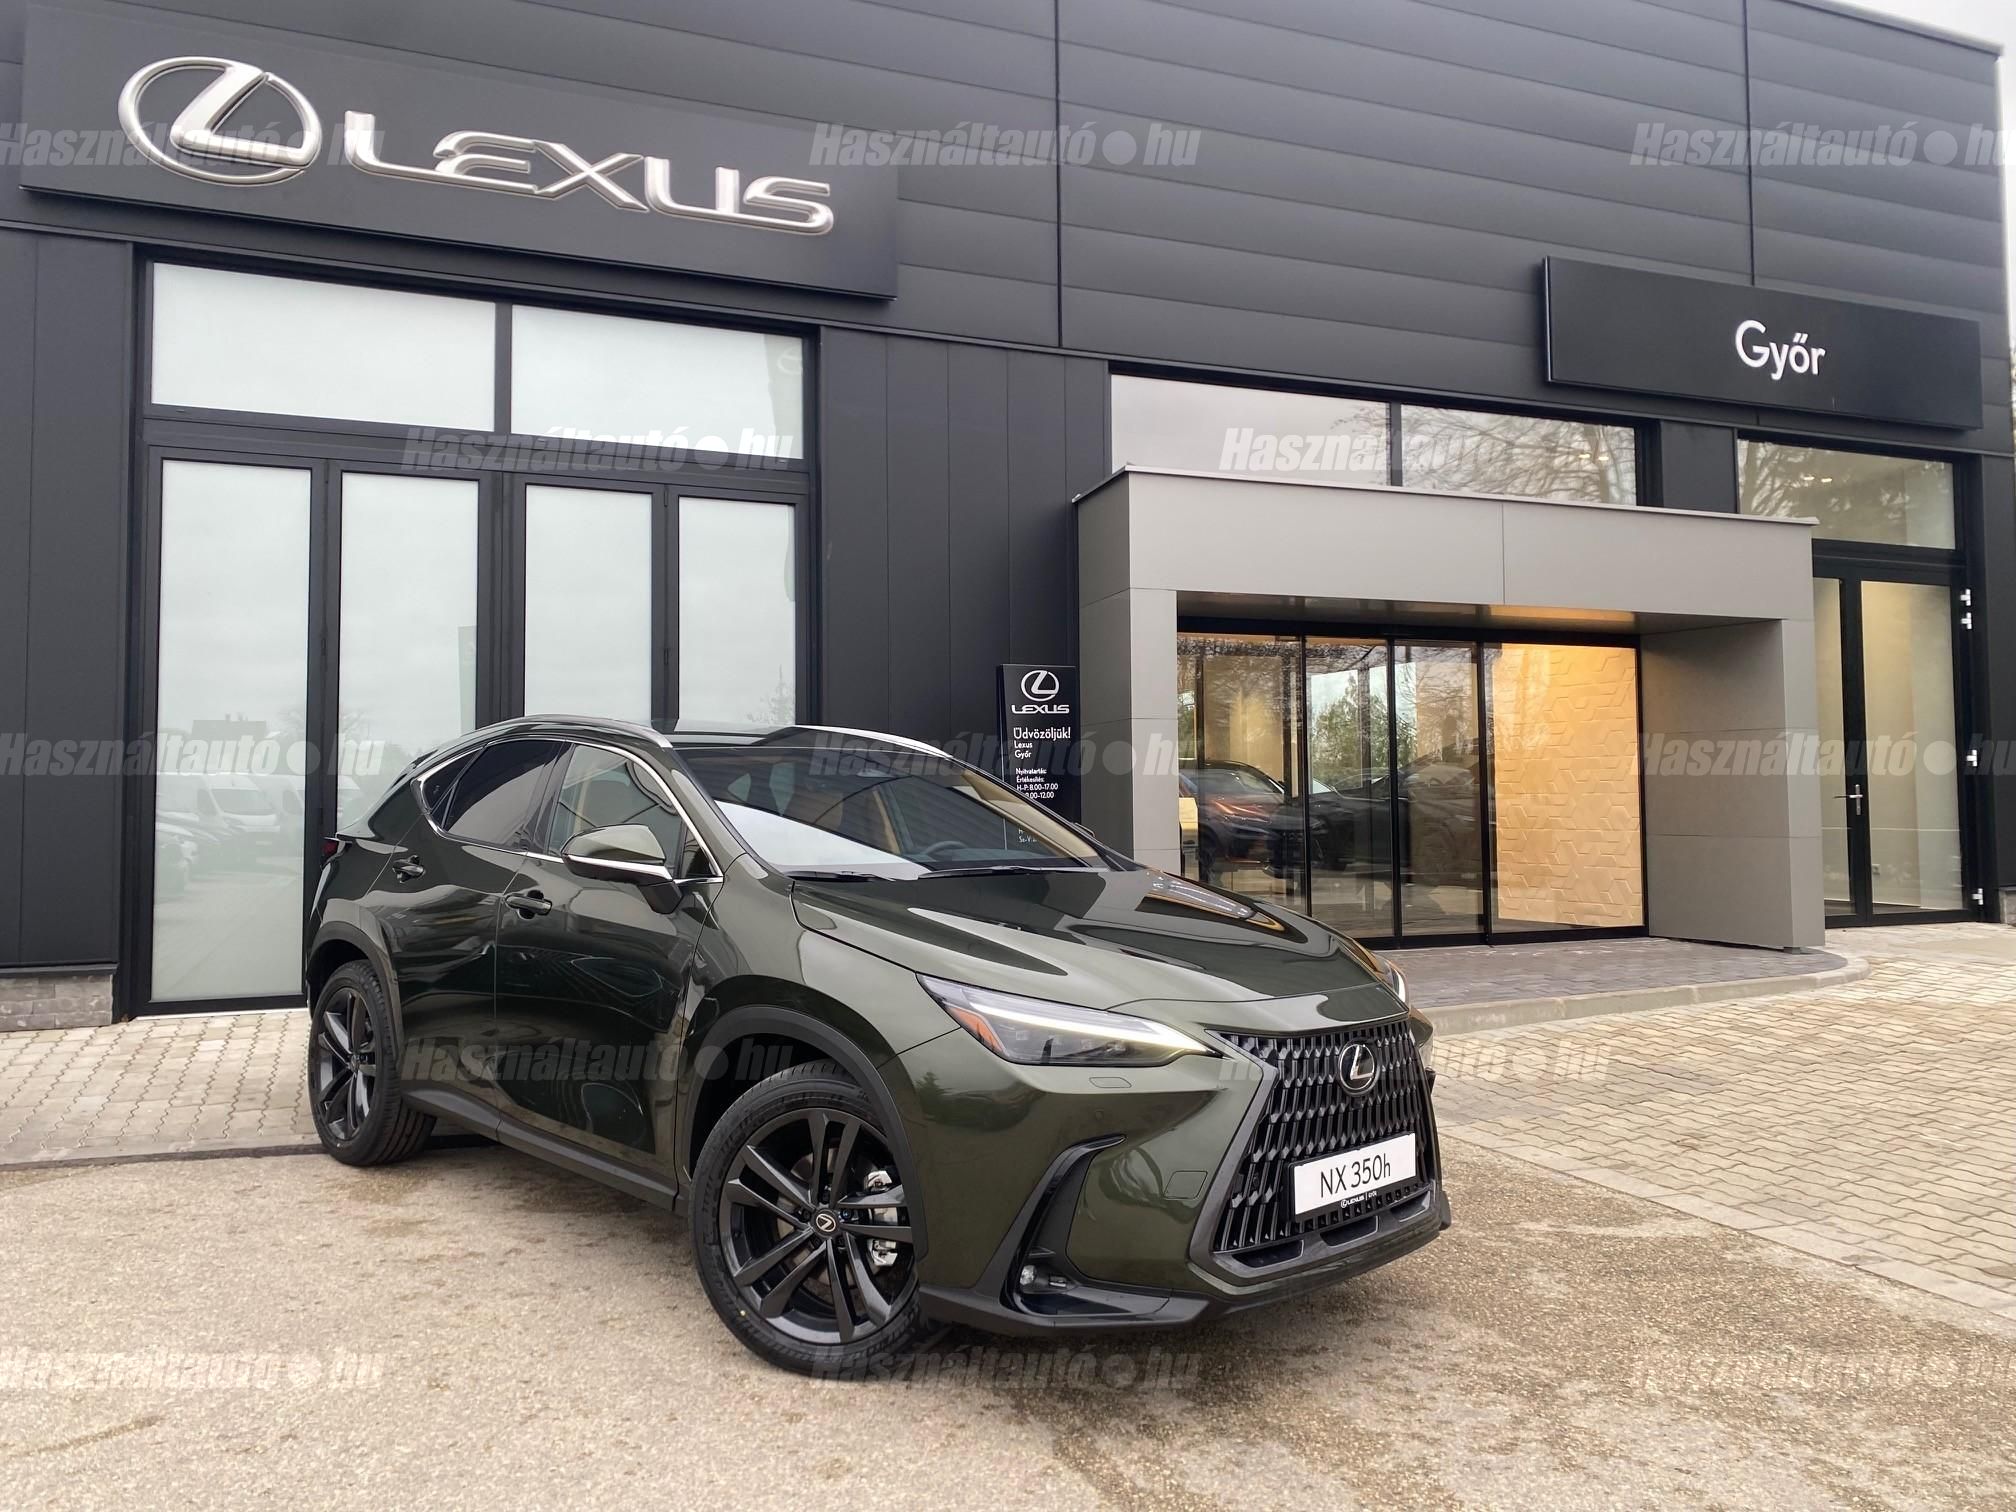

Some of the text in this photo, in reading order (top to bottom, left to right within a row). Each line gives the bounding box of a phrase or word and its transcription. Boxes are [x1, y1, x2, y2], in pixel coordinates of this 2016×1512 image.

[344, 109, 834, 235] LEXUS
[1735, 319, 1826, 380] Győr
[1011, 704, 1070, 714] LEXUS
[1013, 726, 1071, 741] Üdvözöljük!
[1014, 740, 1033, 749] Lexus
[1014, 750, 1032, 759] Győr
[1320, 1153, 1391, 1198] NX 350h
